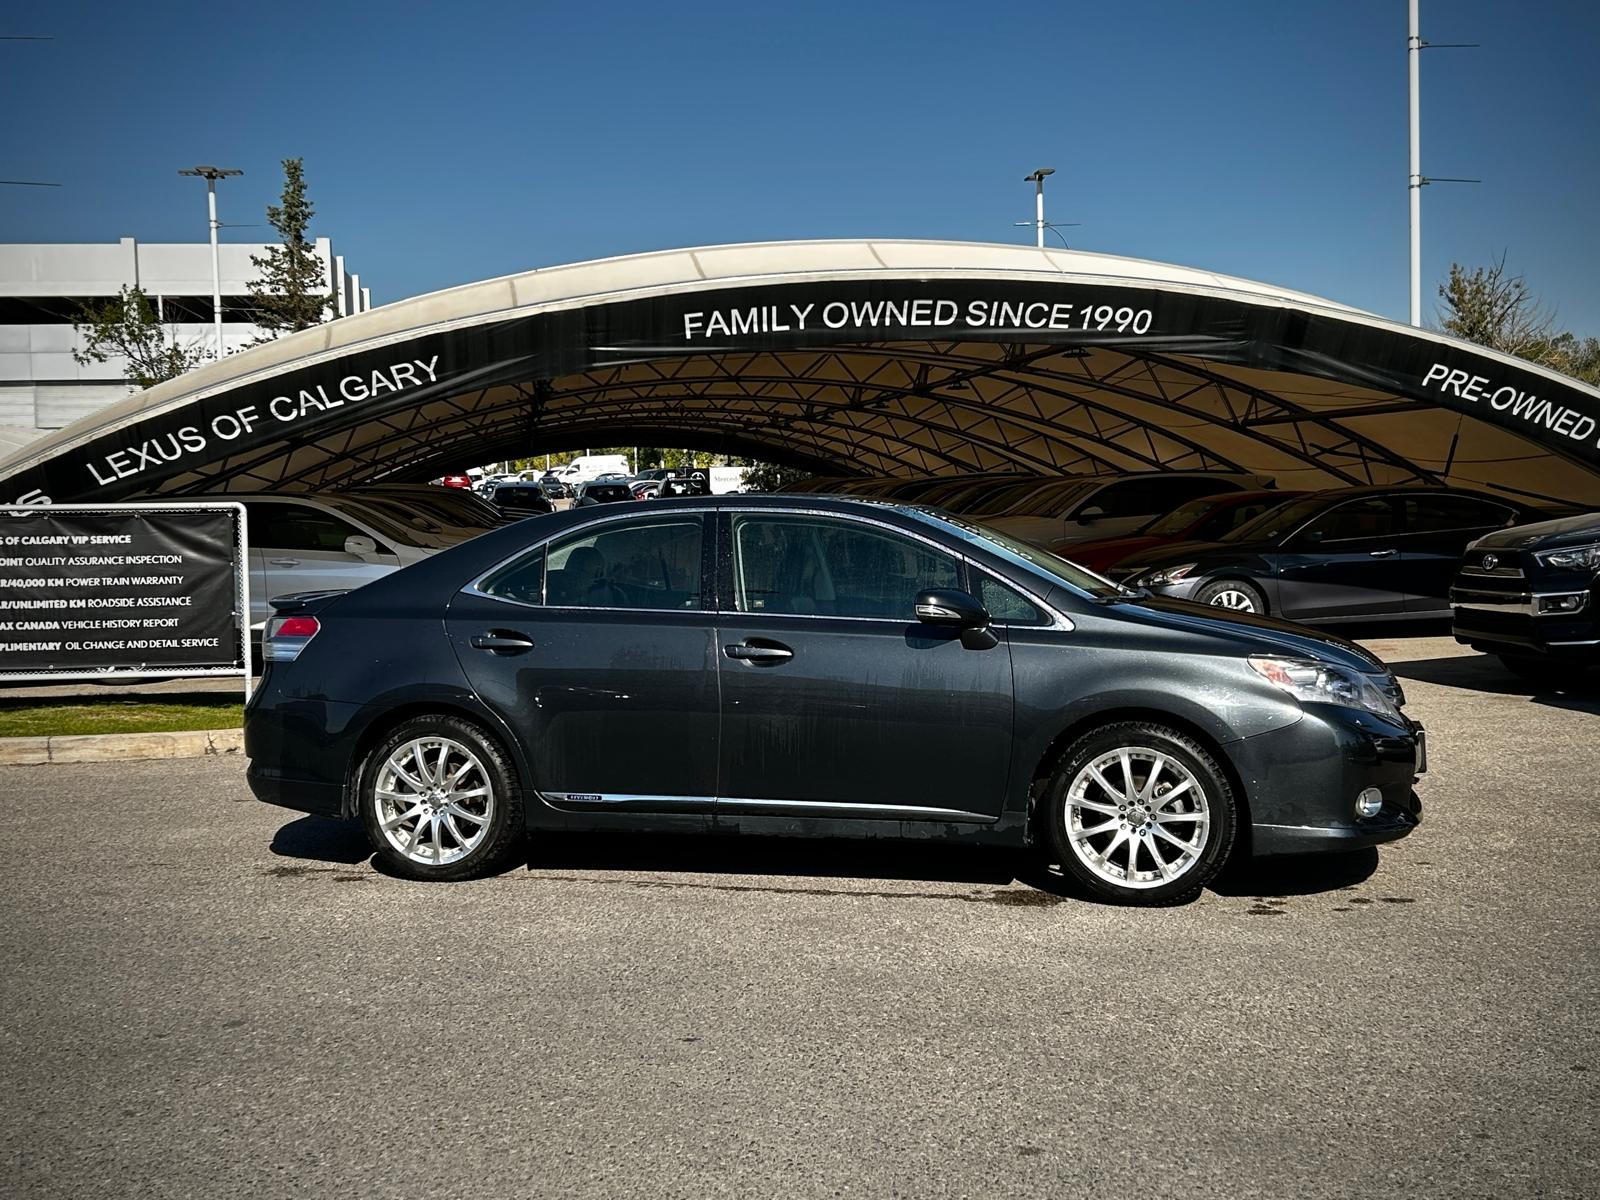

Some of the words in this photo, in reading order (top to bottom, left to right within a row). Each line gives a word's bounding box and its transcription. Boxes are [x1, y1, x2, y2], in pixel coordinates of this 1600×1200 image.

[684, 303, 815, 340] FAMILY
[822, 299, 958, 329] OWNED
[965, 300, 1074, 330] SINCE
[1080, 305, 1153, 335] 1990
[1421, 363, 1596, 441] PRE-OWNED
[86, 427, 207, 486] LEXUS
[211, 406, 260, 441] OF
[269, 355, 439, 422] CALGARY
[5, 536, 20, 546] OF
[21, 536, 70, 545] CALGARY
[71, 535, 89, 544] VIP
[90, 534, 132, 544] SERVICE
[25, 557, 67, 566] QUALITY
[67, 556, 125, 566] ASSURANCE
[125, 555, 182, 564] INSPECTION
[47, 578, 64, 587] KM
[65, 577, 101, 587] POWER
[101, 577, 130, 586] TRAIN
[130, 575, 184, 585] WARRANTY
[0, 600, 68, 609] R/UNLIMITED
[69, 599, 86, 608] KM
[87, 598, 136, 608] ROADSIDE
[136, 596, 192, 607] ASSISTANCE
[15, 621, 61, 630] CANADA
[61, 620, 101, 629] VEHICLE
[102, 619, 142, 628] HISTORY
[143, 618, 180, 627] REPORT
[65, 641, 82, 650] OIL
[82, 640, 126, 650] CHANGE
[126, 640, 149, 649] AND
[149, 639, 181, 648] DETAIL
[181, 637, 219, 647] SERVICE
